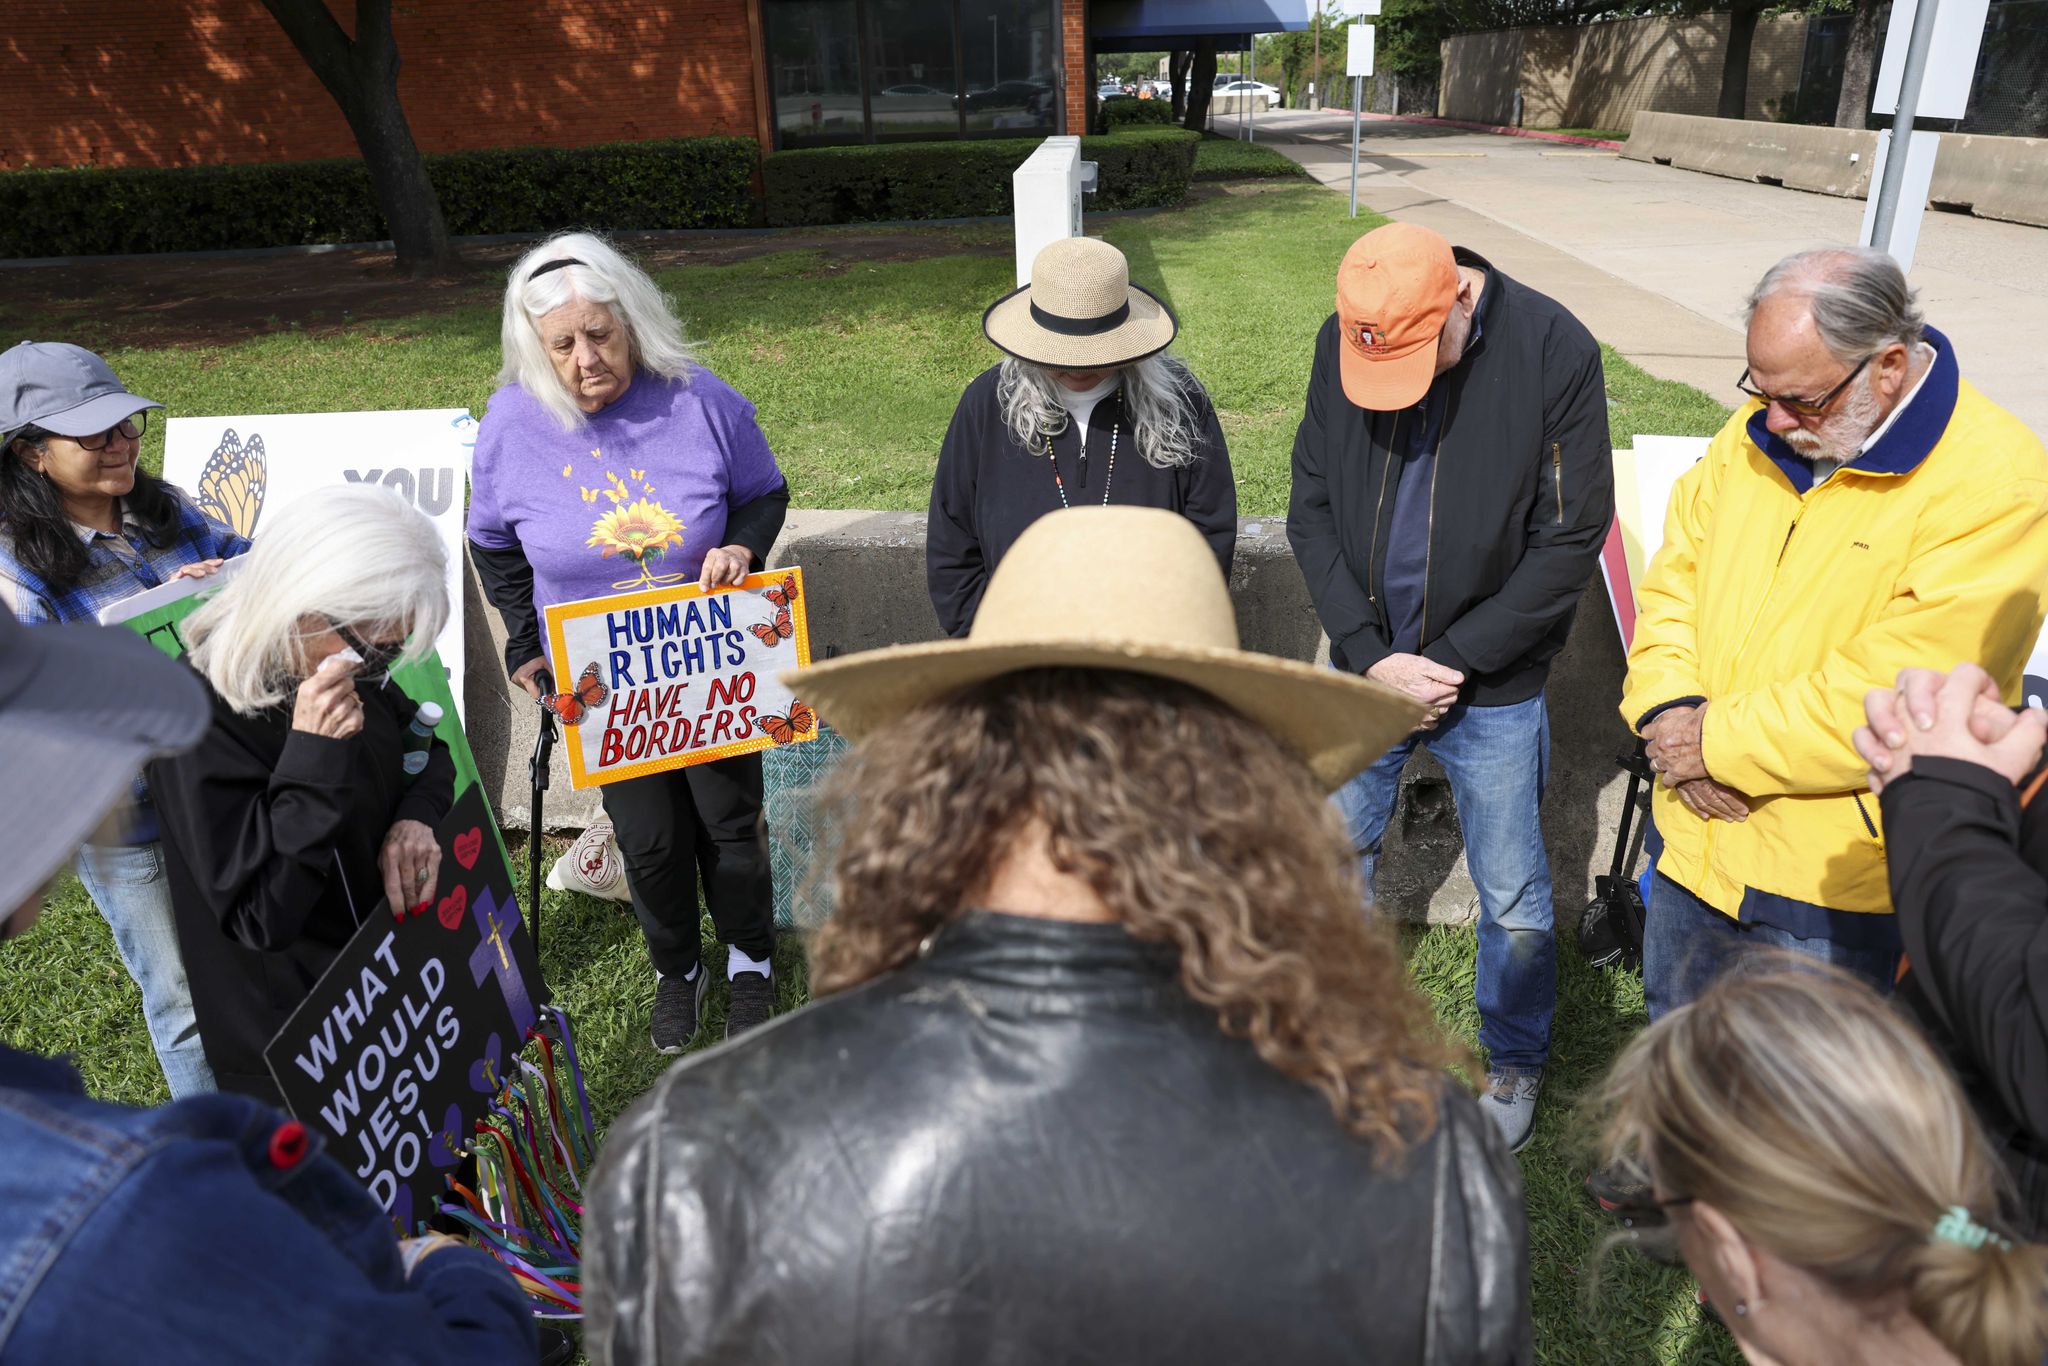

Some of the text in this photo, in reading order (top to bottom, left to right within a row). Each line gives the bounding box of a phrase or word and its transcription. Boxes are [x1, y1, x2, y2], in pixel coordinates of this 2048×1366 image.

[607, 595, 732, 648] HUMAN
[609, 630, 745, 689] RIGHTS
[599, 705, 757, 768] BORDERS
[607, 671, 756, 728] HAVE NO
[294, 931, 400, 1083] WHAT
[320, 958, 446, 1137] WOULD
[356, 1006, 461, 1178] JESUS
[367, 1109, 433, 1214] DO!
